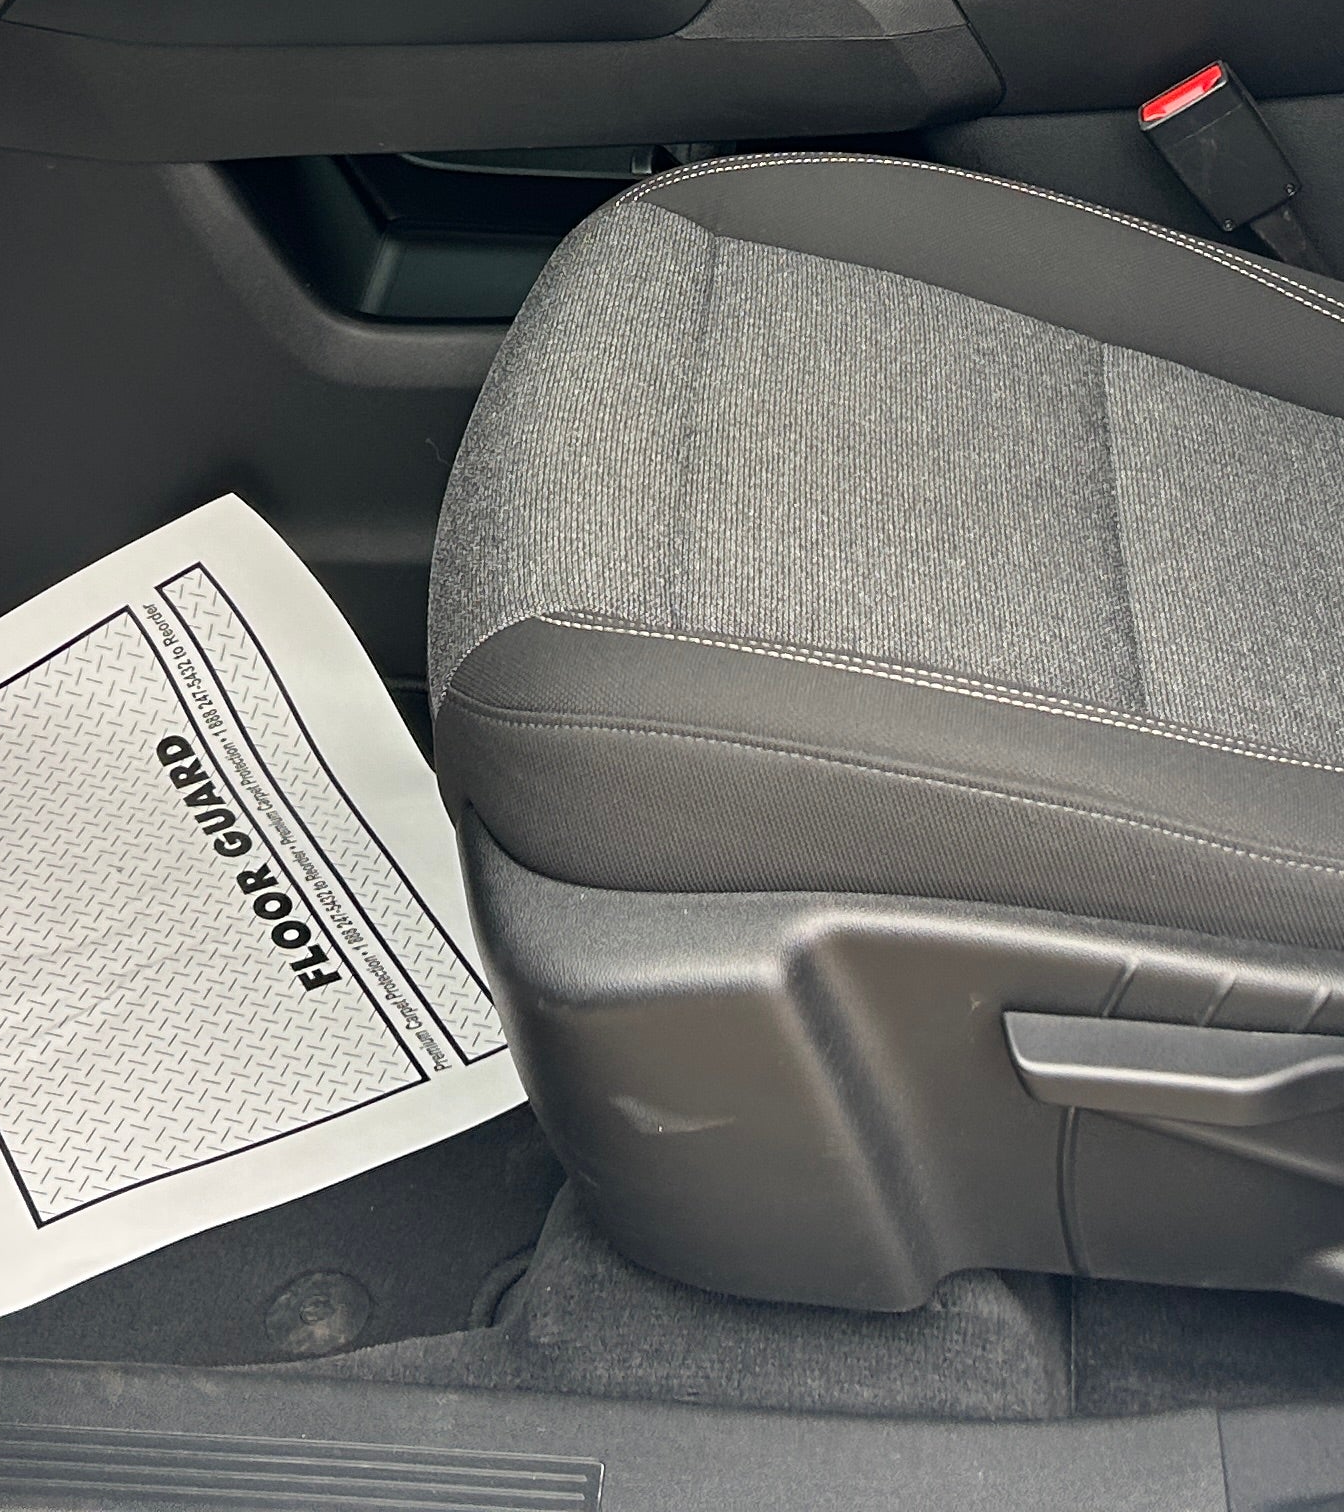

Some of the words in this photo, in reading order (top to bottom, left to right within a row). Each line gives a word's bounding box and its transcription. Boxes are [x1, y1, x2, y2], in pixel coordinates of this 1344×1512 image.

[142, 603, 178, 648] Reorder
[172, 646, 188, 660] to
[176, 657, 214, 710] 247-5432
[202, 708, 225, 730] 888
[223, 742, 257, 787] Protection
[155, 734, 253, 858] GUARD
[235, 862, 343, 992] FLOOR
[364, 955, 404, 1001] Protection
[391, 999, 424, 1030] Carpet
[415, 1029, 453, 1072] Premium
